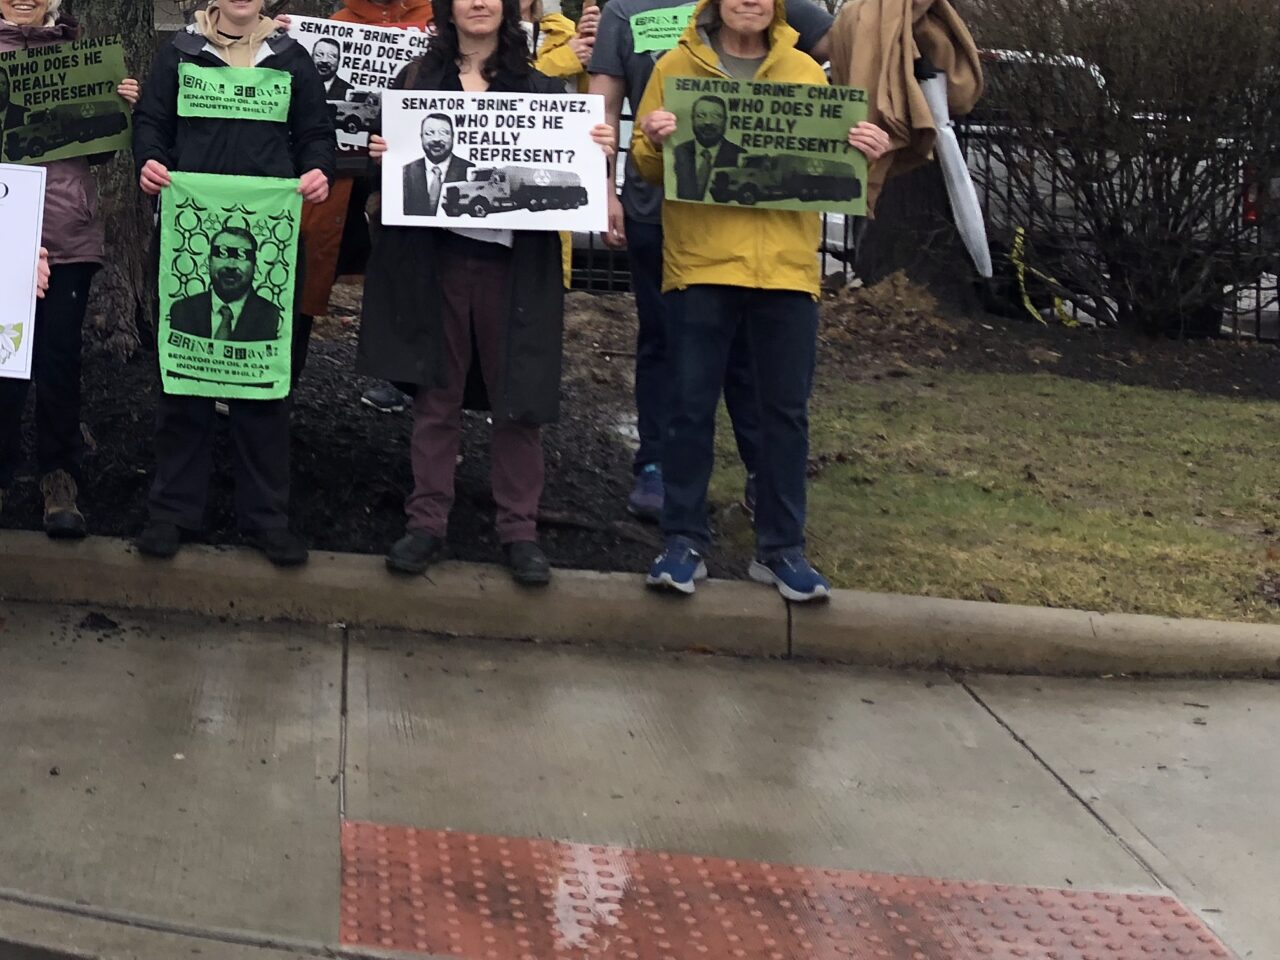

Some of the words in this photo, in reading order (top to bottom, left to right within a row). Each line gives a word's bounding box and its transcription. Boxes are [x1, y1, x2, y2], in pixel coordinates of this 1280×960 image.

[300, 22, 353, 38] SENATOR
[360, 29, 405, 44] "BRINE"
[342, 41, 371, 56] WHO
[378, 46, 413, 62] DOES
[9, 63, 38, 77] WHO
[44, 55, 79, 71] DOES
[84, 51, 102, 65] HE
[342, 57, 397, 75] REALLY
[13, 72, 66, 92] REALLY
[676, 79, 740, 93] SENATOR
[747, 82, 802, 98] "BRINE"
[24, 81, 114, 106] REPRESENT?
[402, 98, 464, 110] SENATOR
[472, 99, 524, 111] "BRINE"
[530, 100, 591, 114] CHAVEZ,
[728, 98, 763, 113] WHO
[771, 100, 813, 116] DOES
[821, 104, 842, 119] HE
[455, 115, 488, 127] WHO
[495, 115, 535, 129] DOES
[543, 116, 563, 129] HE
[730, 116, 797, 133] REALLY
[458, 131, 520, 145] REALLY
[742, 134, 849, 154] REPRESENT?
[470, 148, 575, 163] REPRESENT?
